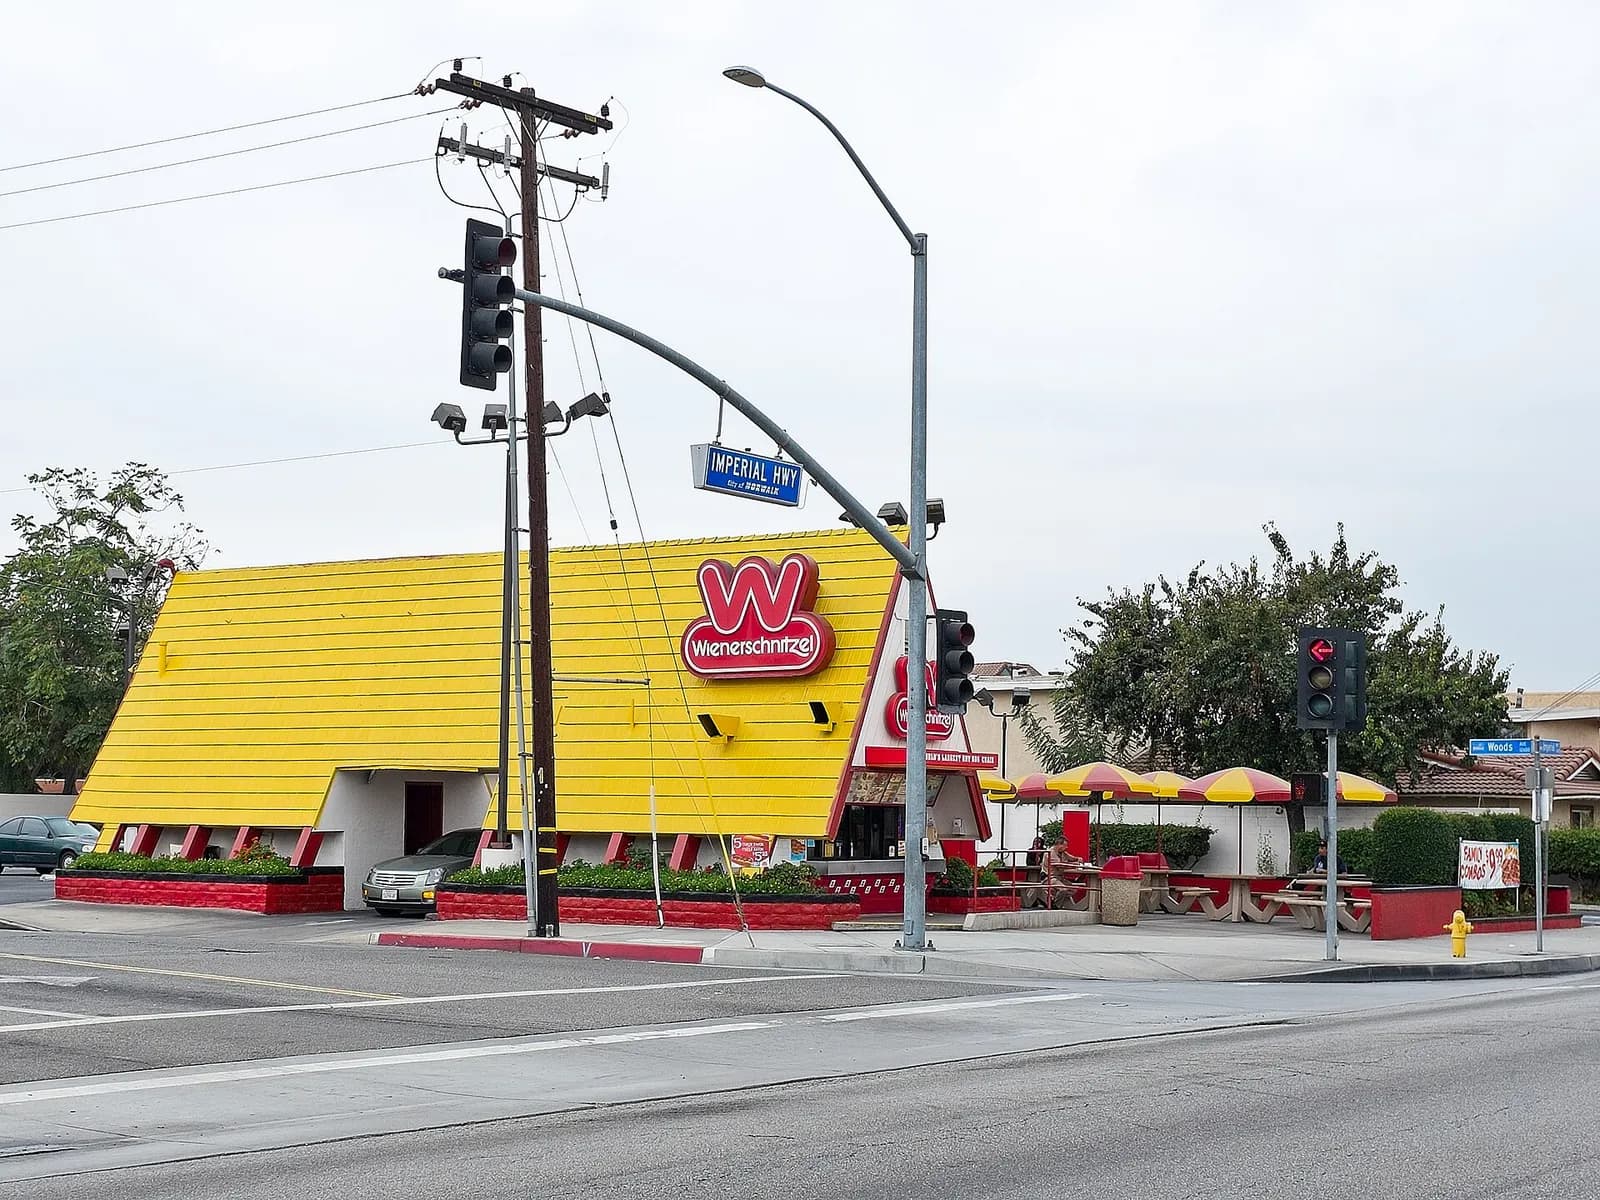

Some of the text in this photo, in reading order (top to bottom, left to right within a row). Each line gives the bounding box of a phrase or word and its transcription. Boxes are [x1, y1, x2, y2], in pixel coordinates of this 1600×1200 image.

[711, 452, 798, 488] IMPERIAL HWY
[727, 480, 737, 489] City
[744, 482, 780, 496] NORWALK
[699, 557, 804, 635] W
[691, 634, 814, 658] Wienerschnitzel
[900, 709, 951, 728] Wchnitzel
[1487, 743, 1513, 752] Woods
[733, 837, 742, 849] 5
[1463, 846, 1483, 863] FAMILY
[1460, 864, 1486, 880] COMBOS
